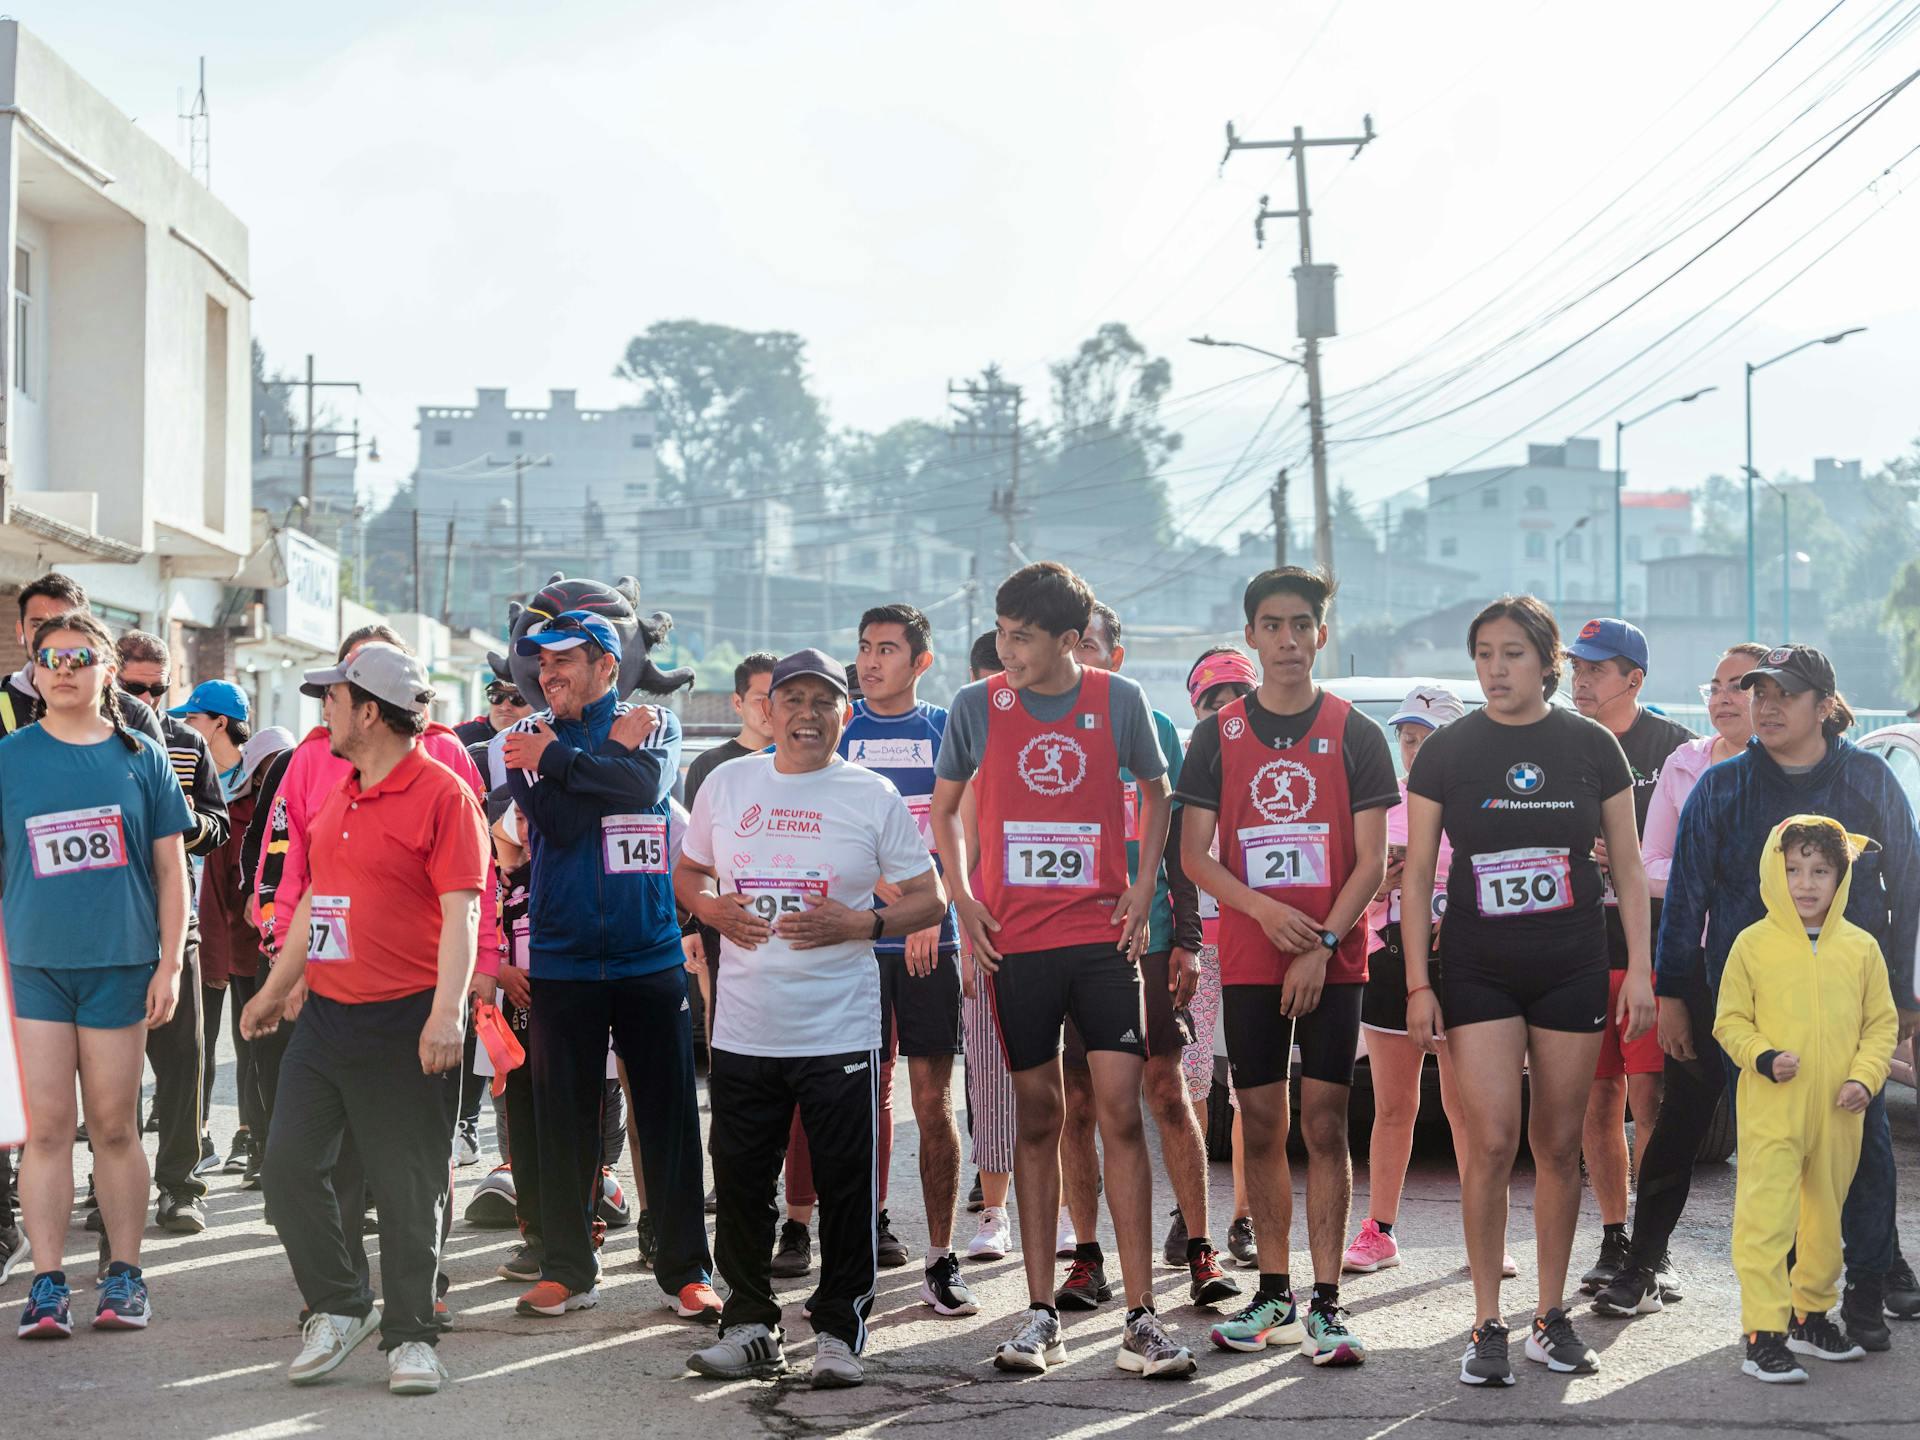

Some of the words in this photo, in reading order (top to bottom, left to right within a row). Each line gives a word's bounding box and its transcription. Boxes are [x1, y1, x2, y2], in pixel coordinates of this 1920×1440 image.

[771, 808, 823, 820] IMCUFIDE
[1510, 800, 1575, 810] Motorsport
[767, 819, 822, 833] LERMA
[45, 833, 110, 866] 108
[617, 839, 661, 864] 145
[1020, 849, 1082, 879] 129
[1265, 850, 1300, 879] 21
[1489, 873, 1556, 908] 130
[756, 895, 801, 922] 95
[843, 1061, 868, 1074] Wilson
